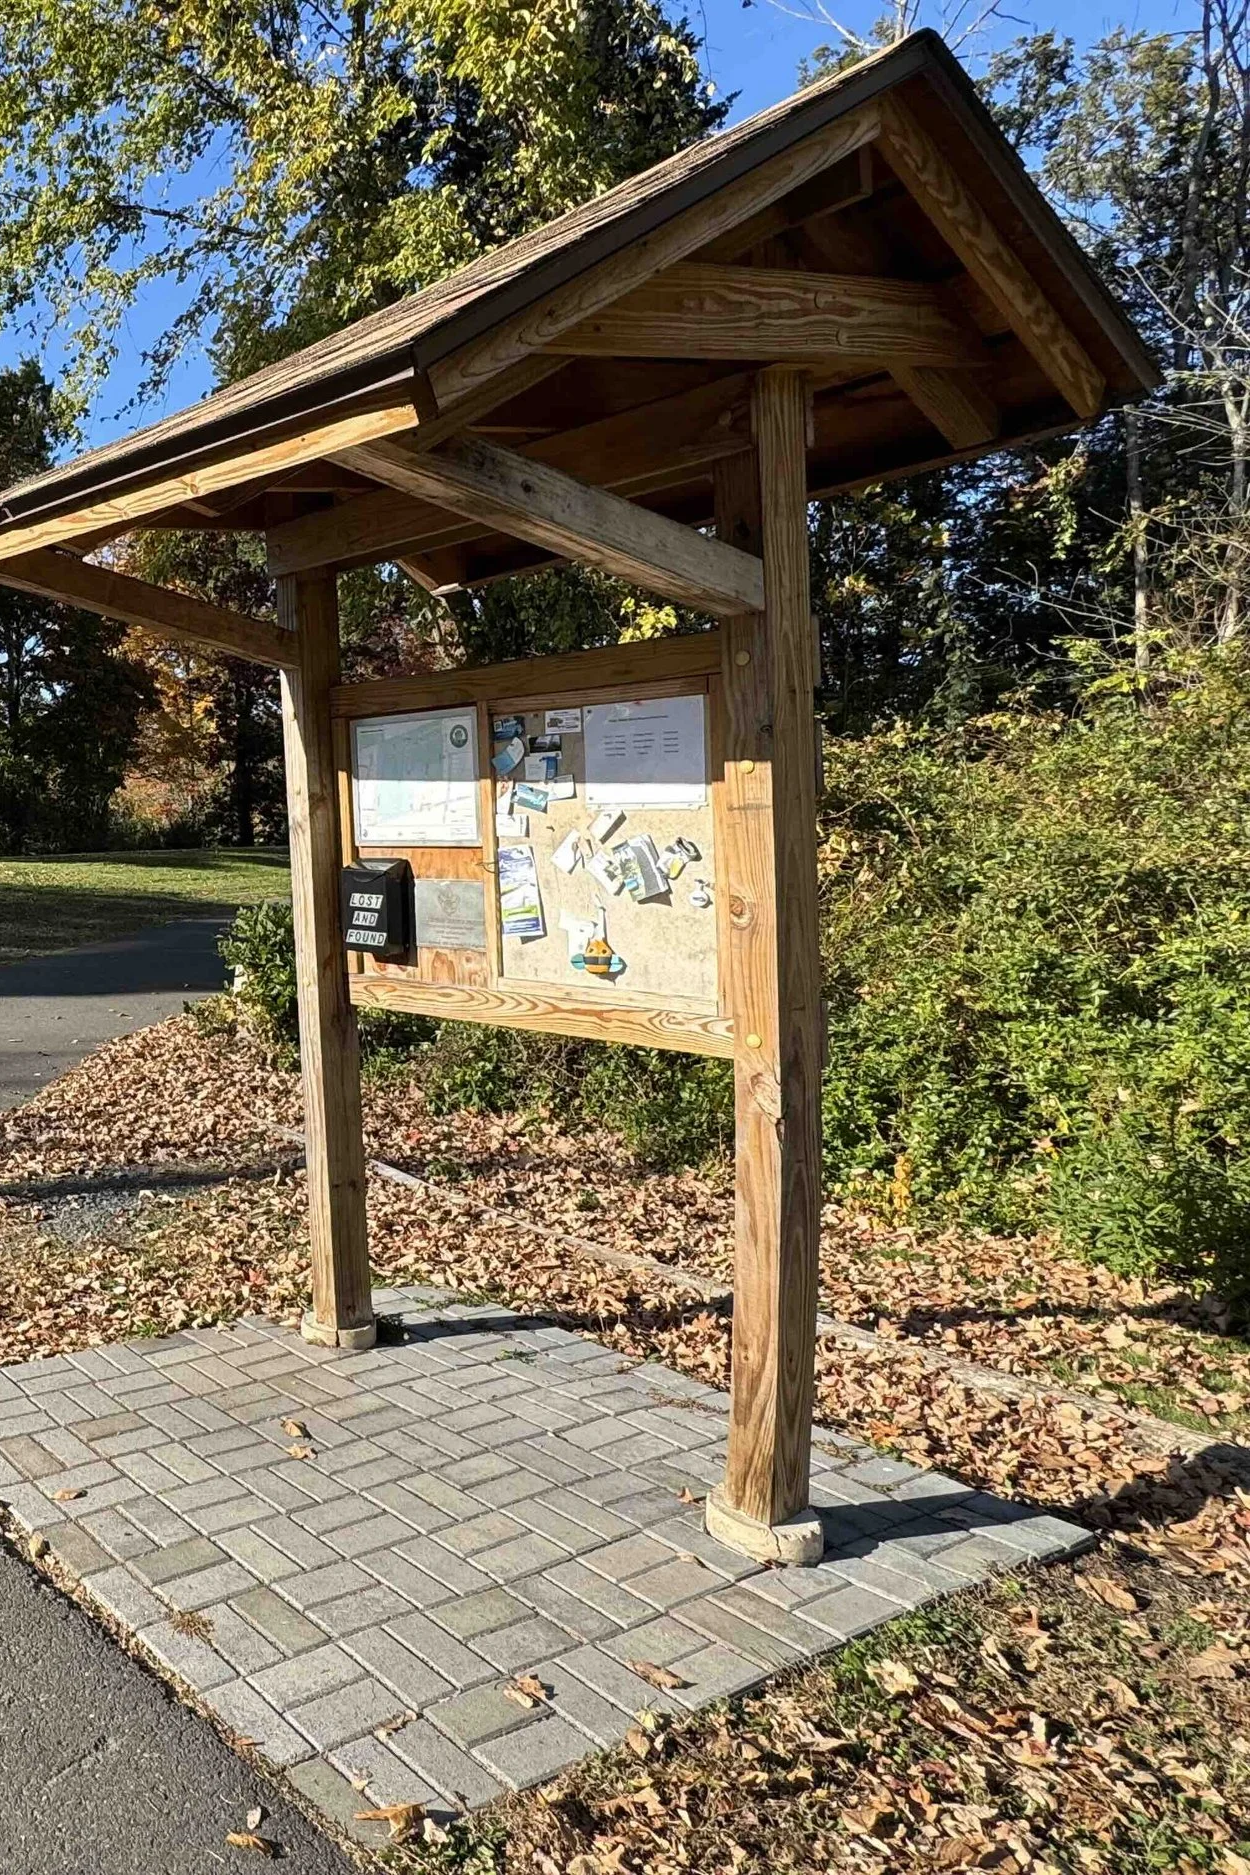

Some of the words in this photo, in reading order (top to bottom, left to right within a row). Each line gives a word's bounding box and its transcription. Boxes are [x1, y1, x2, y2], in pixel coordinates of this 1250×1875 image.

[351, 894, 381, 907] LOST
[354, 912, 376, 925] AND
[348, 931, 385, 945] FOUND
